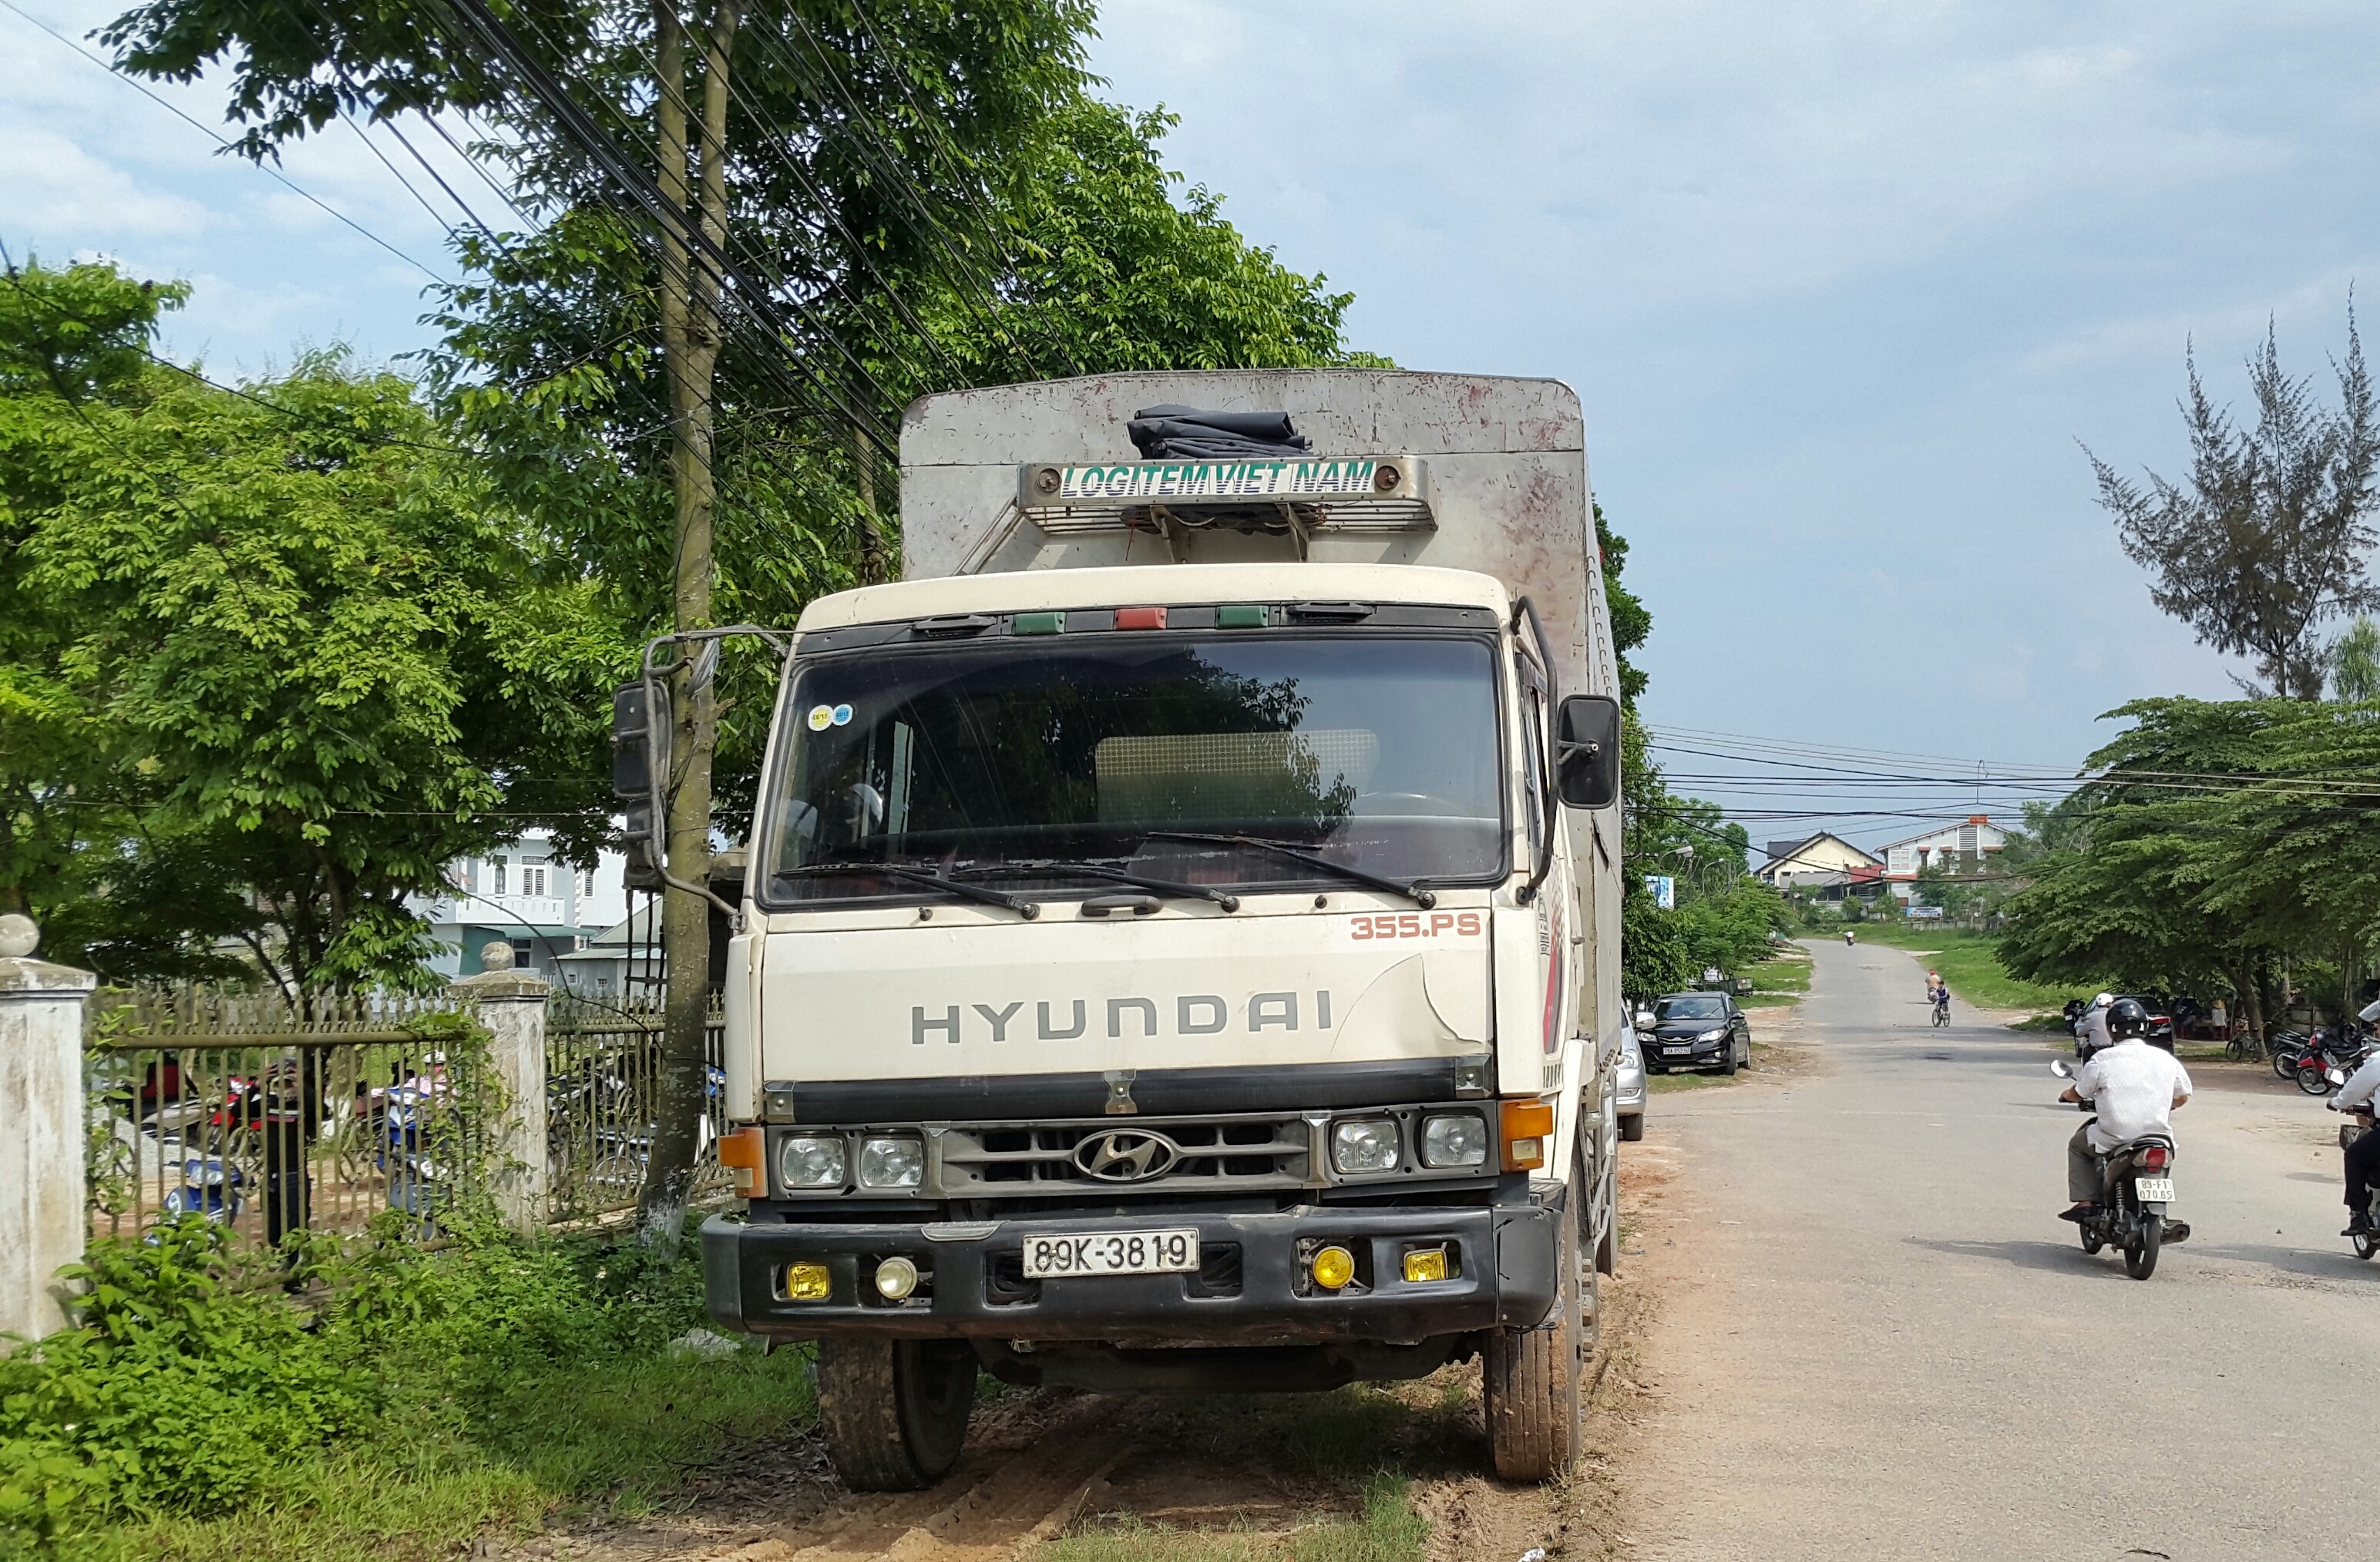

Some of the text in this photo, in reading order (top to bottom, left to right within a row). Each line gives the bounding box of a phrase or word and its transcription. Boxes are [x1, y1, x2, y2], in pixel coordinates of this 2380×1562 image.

[1061, 462, 1375, 498] LOGITEM VIET NAM
[1350, 913, 1481, 940] 355.PS
[912, 990, 1332, 1044] HYUNDAI
[1034, 1234, 1187, 1272] 89K-3819
